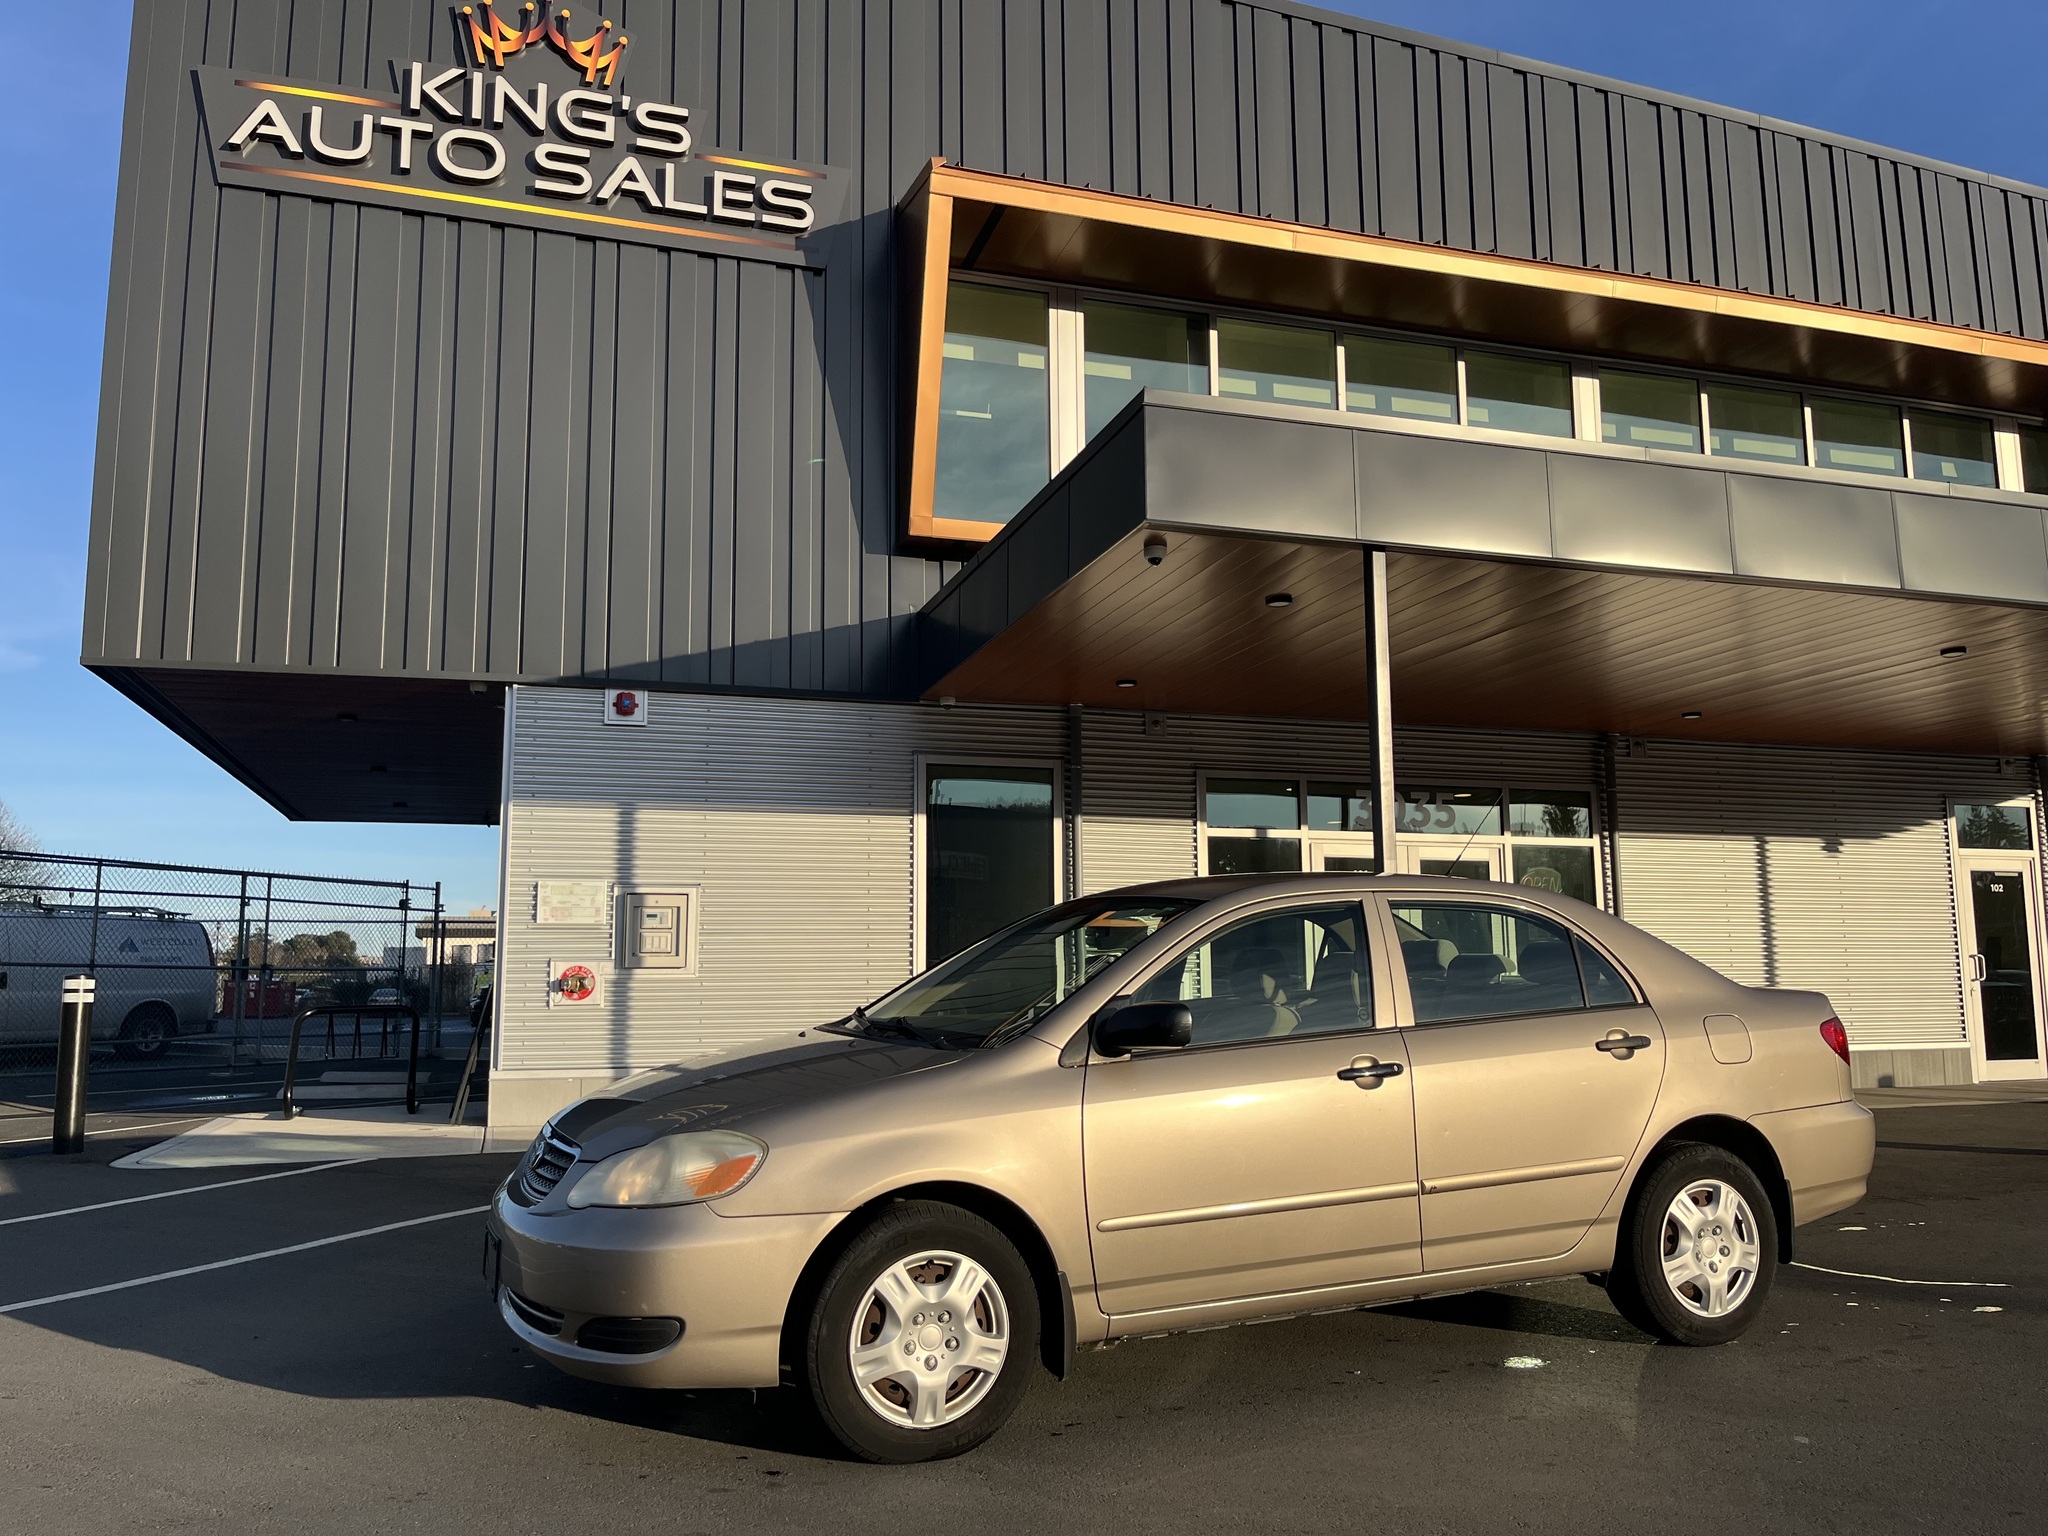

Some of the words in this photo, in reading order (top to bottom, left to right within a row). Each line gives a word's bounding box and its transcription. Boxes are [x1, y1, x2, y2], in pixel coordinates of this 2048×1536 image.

[410, 60, 692, 154] KING'S
[227, 98, 508, 181] AUTO
[534, 142, 817, 233] SALES
[1990, 883, 2004, 893] 102
